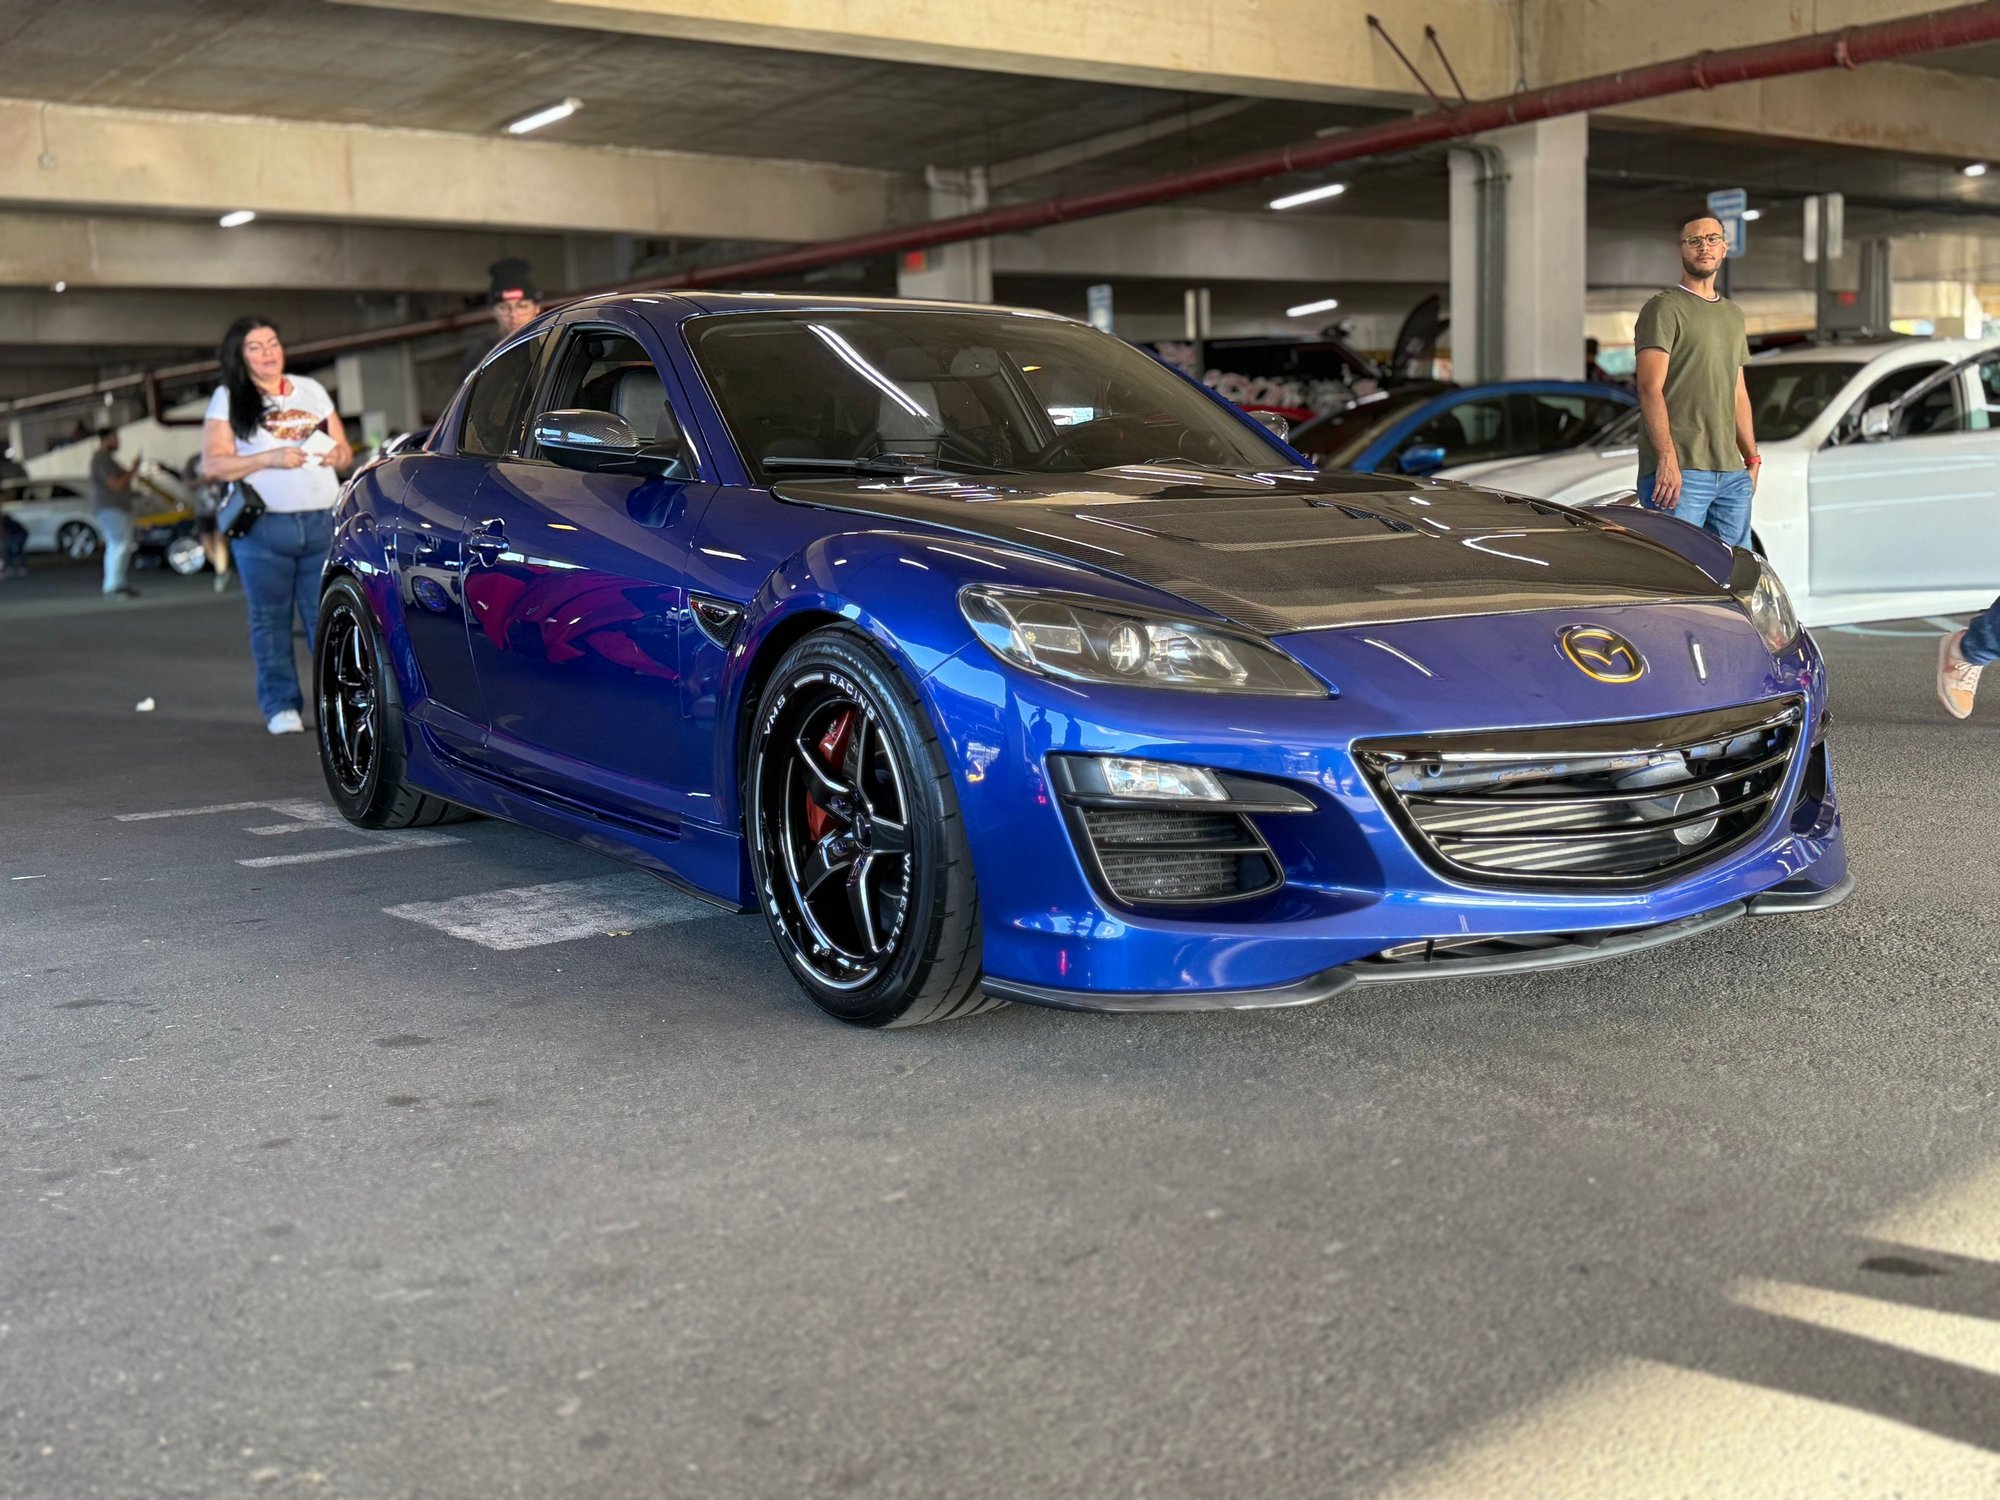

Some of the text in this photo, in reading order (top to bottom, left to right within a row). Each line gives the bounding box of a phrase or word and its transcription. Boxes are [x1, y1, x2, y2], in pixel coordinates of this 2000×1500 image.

[763, 694, 786, 735] VMS
[829, 673, 875, 720] RACING
[886, 852, 911, 954] WHEELS
